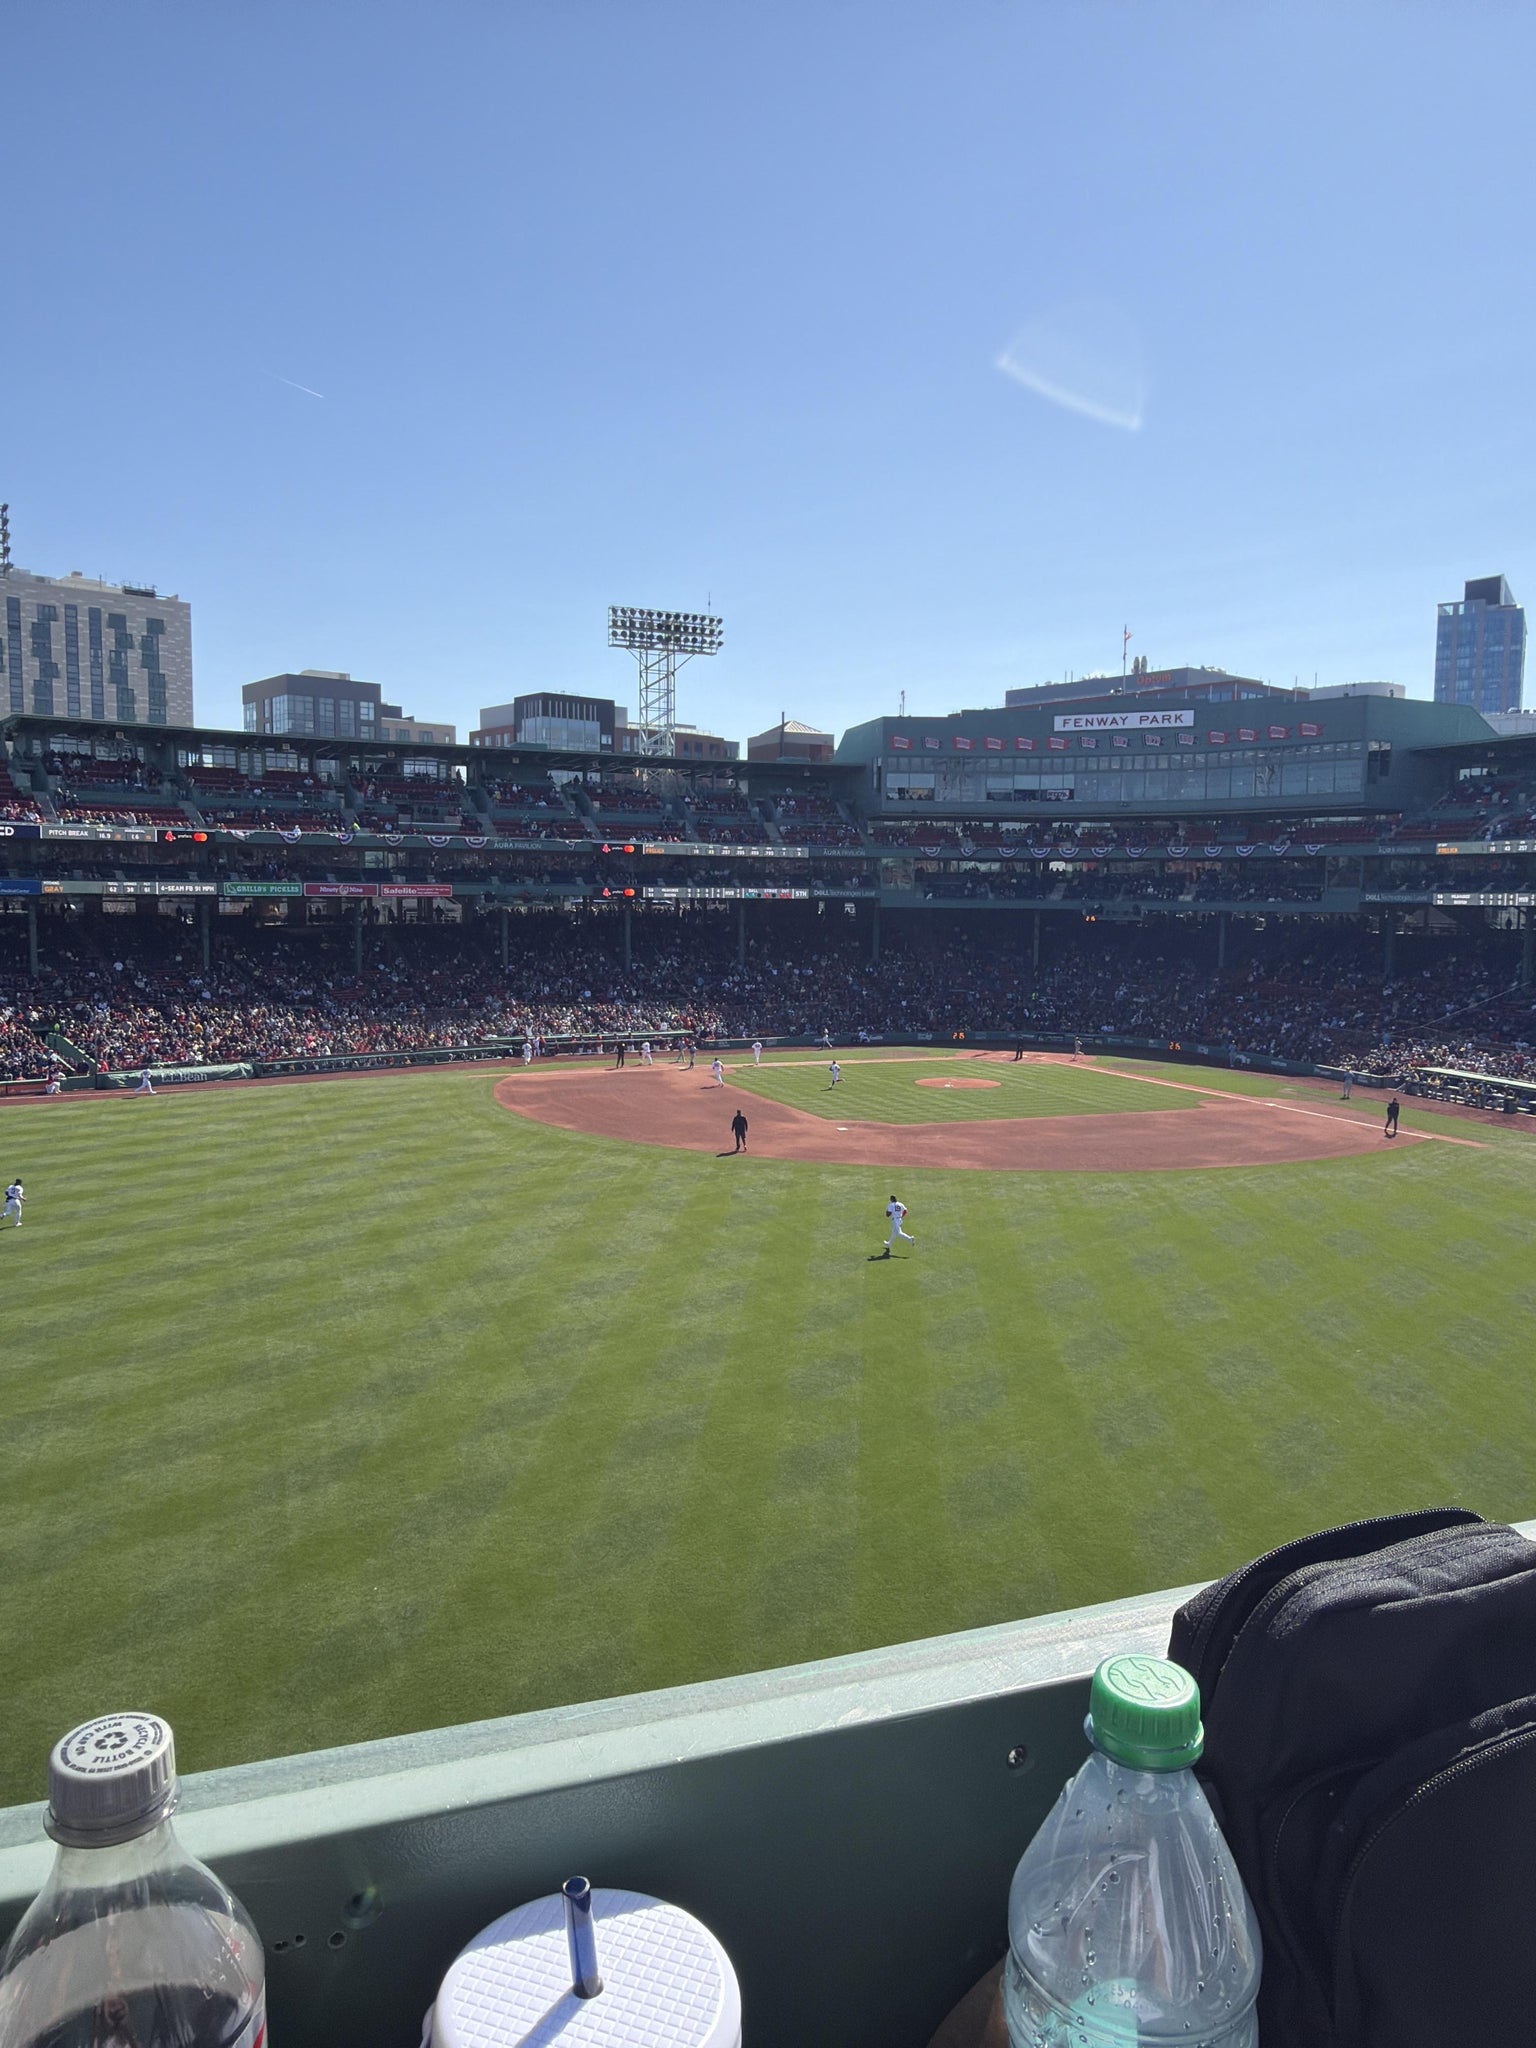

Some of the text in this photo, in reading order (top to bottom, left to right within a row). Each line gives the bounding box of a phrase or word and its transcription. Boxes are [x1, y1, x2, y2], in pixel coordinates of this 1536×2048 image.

[1062, 713, 1184, 728] FENWAY PARK
[383, 887, 417, 895] Safelite
[161, 1072, 208, 1083] L.L.Bean
[75, 1721, 122, 1756] WITH CAP ON
[92, 1724, 149, 1763] RECYCLE BOTTLE
